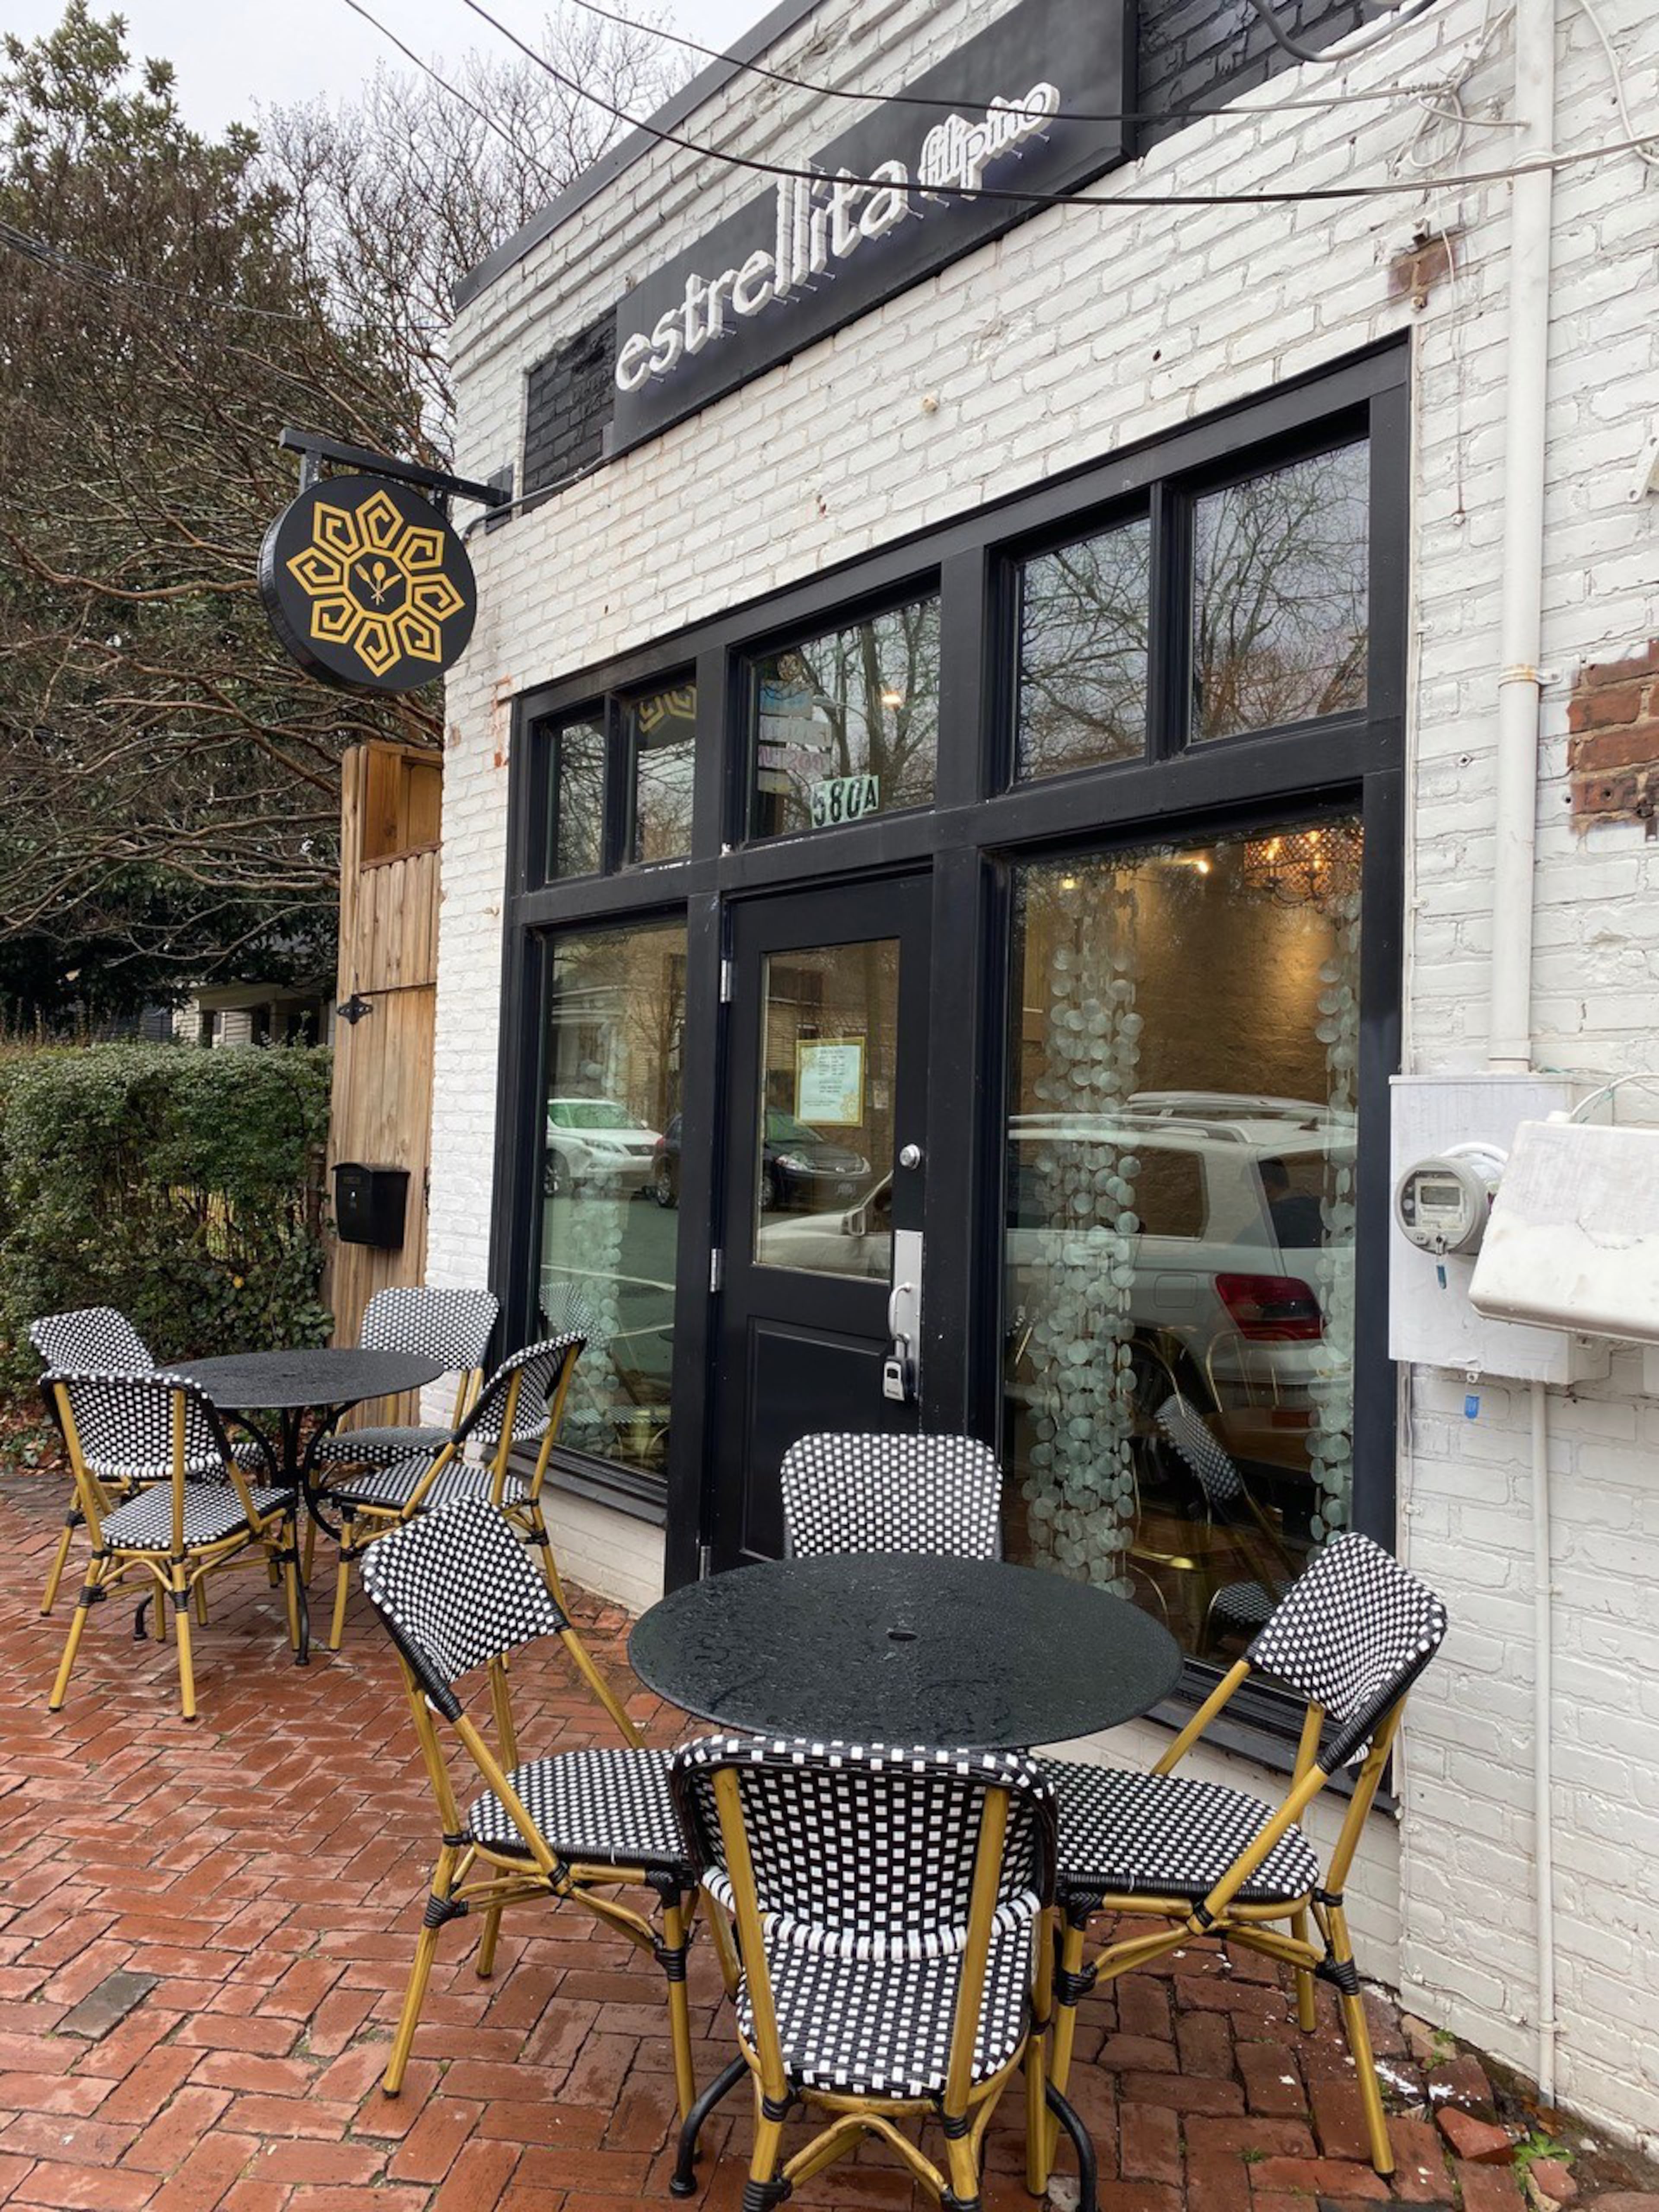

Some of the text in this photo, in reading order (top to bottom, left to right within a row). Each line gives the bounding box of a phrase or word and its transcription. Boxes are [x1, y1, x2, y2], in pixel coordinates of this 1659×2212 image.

[615, 81, 1060, 392] estrellita filipino
[813, 778, 876, 826] 580A
